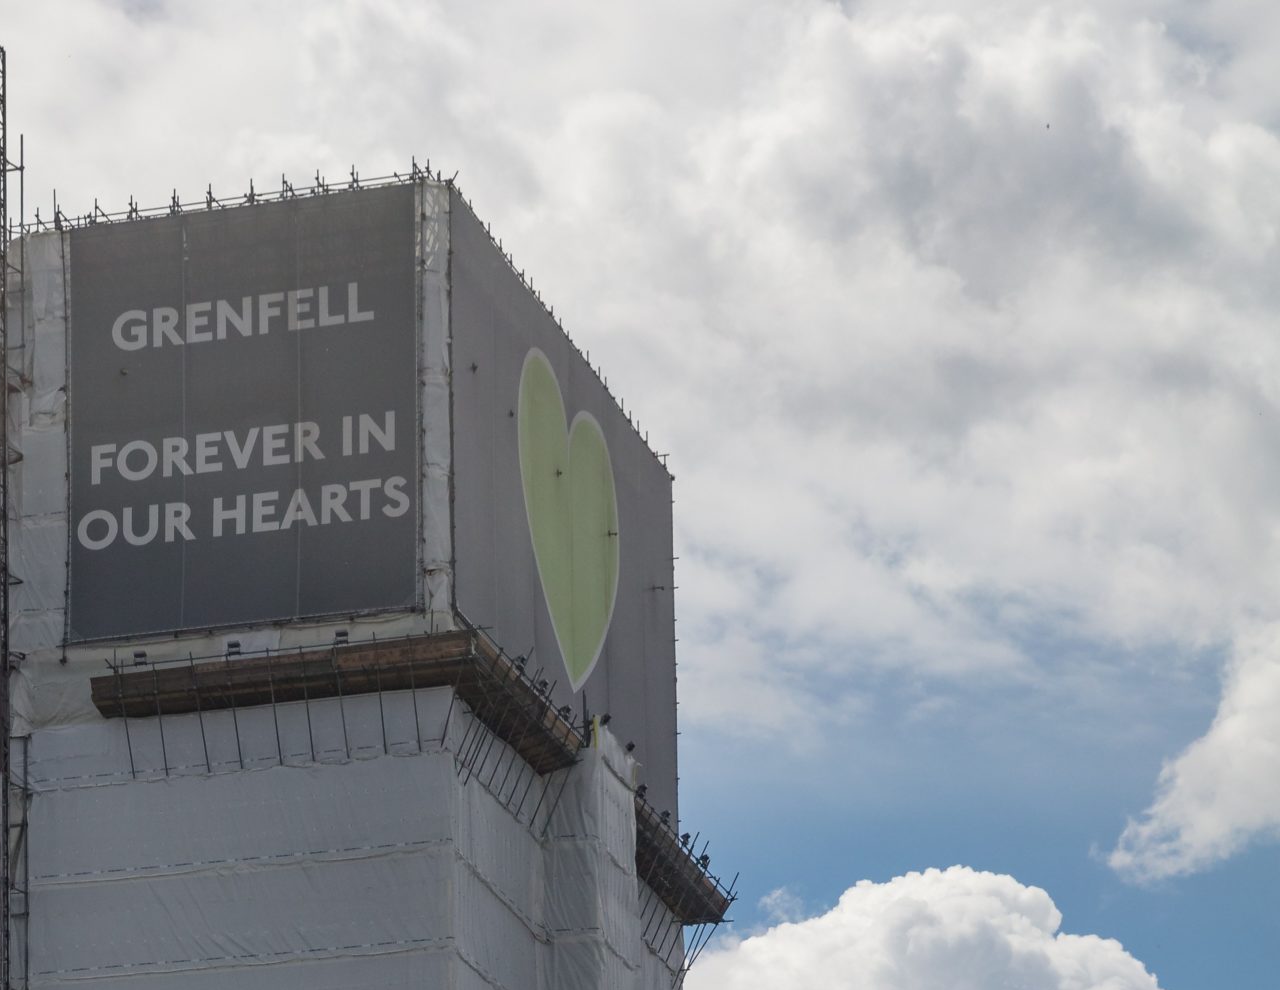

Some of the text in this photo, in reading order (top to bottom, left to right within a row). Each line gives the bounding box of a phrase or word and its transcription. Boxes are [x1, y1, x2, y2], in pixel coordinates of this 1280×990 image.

[112, 283, 374, 351] GRENFELL
[91, 411, 396, 485] FOREVER IN
[77, 476, 410, 551] OUR HEARTS
